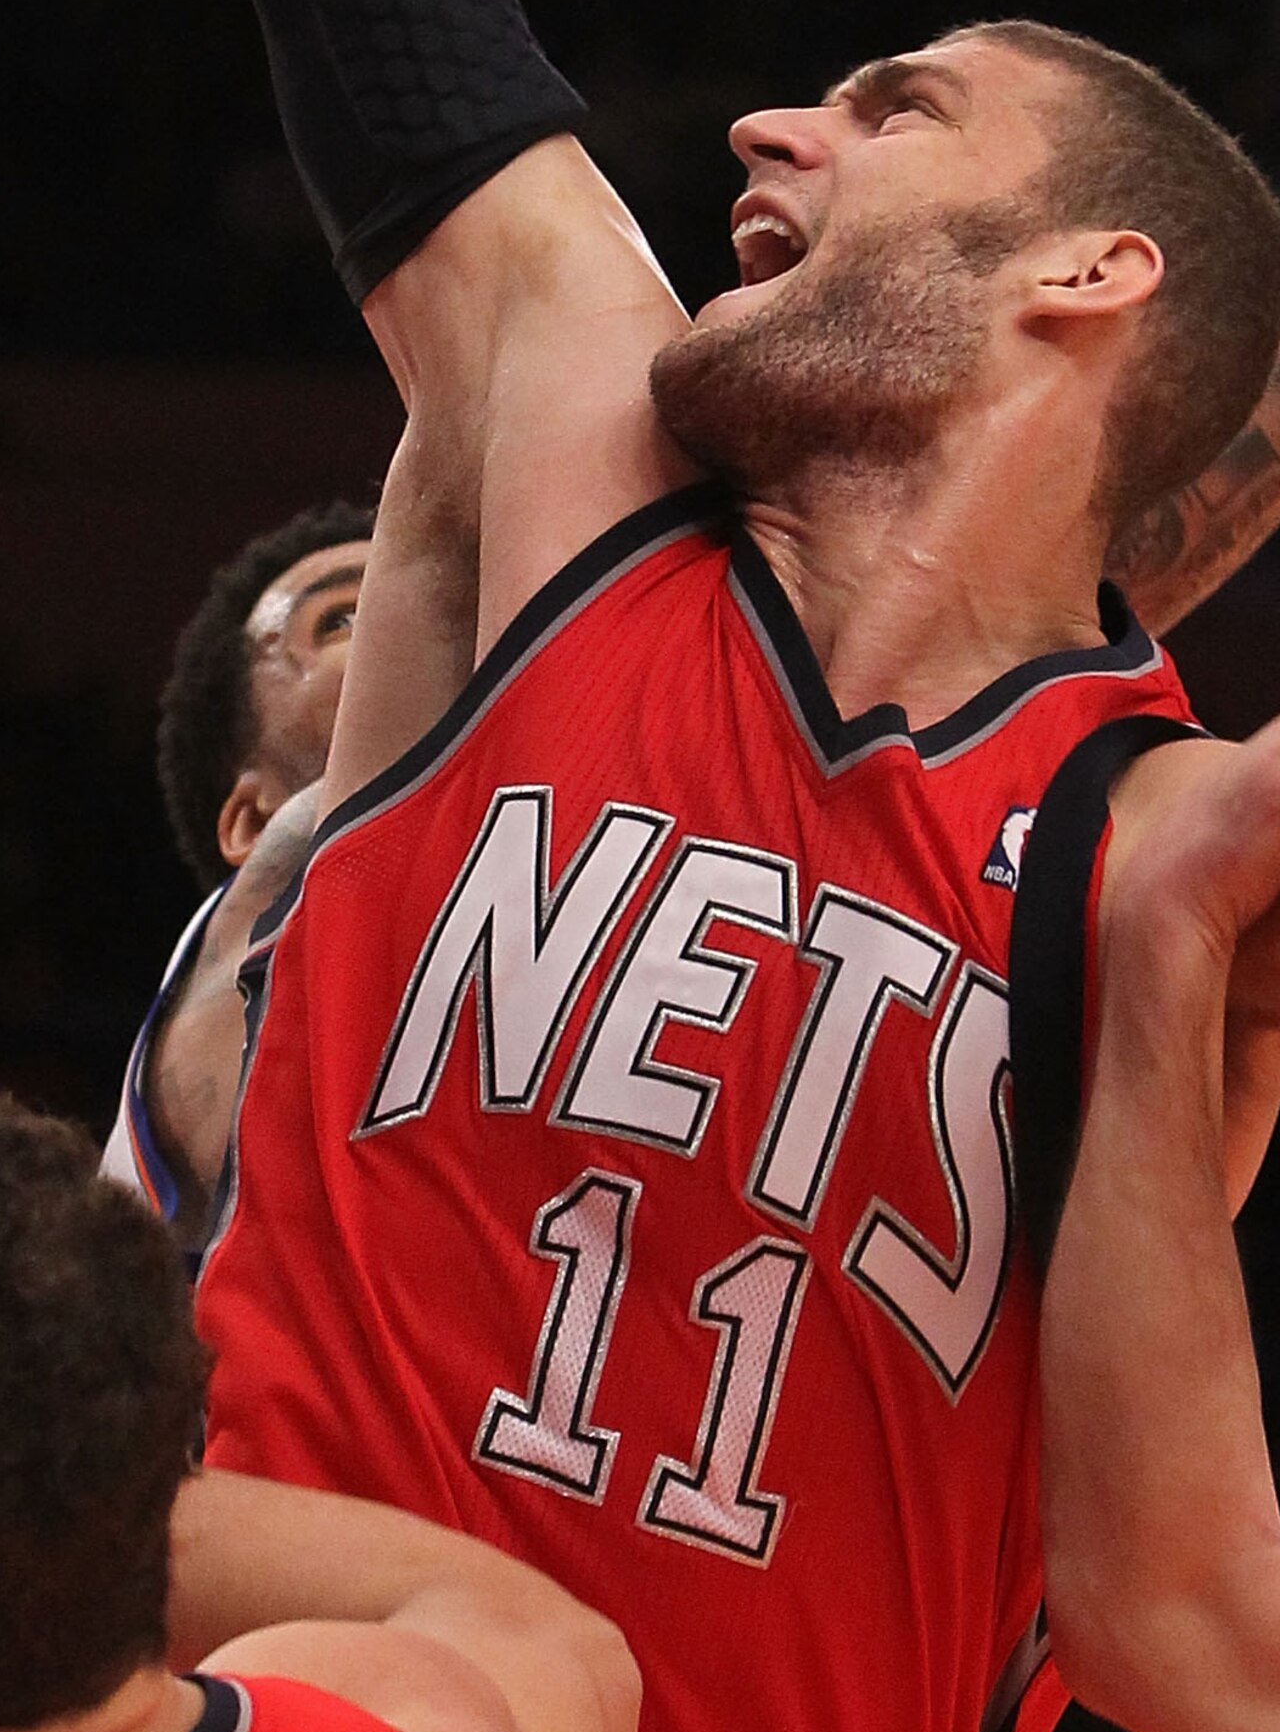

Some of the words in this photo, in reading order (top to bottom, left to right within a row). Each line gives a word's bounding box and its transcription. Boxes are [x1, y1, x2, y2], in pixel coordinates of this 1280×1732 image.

[983, 864, 1014, 885] NBA
[349, 784, 1017, 1407] NETS
[472, 1166, 809, 1568] 11
